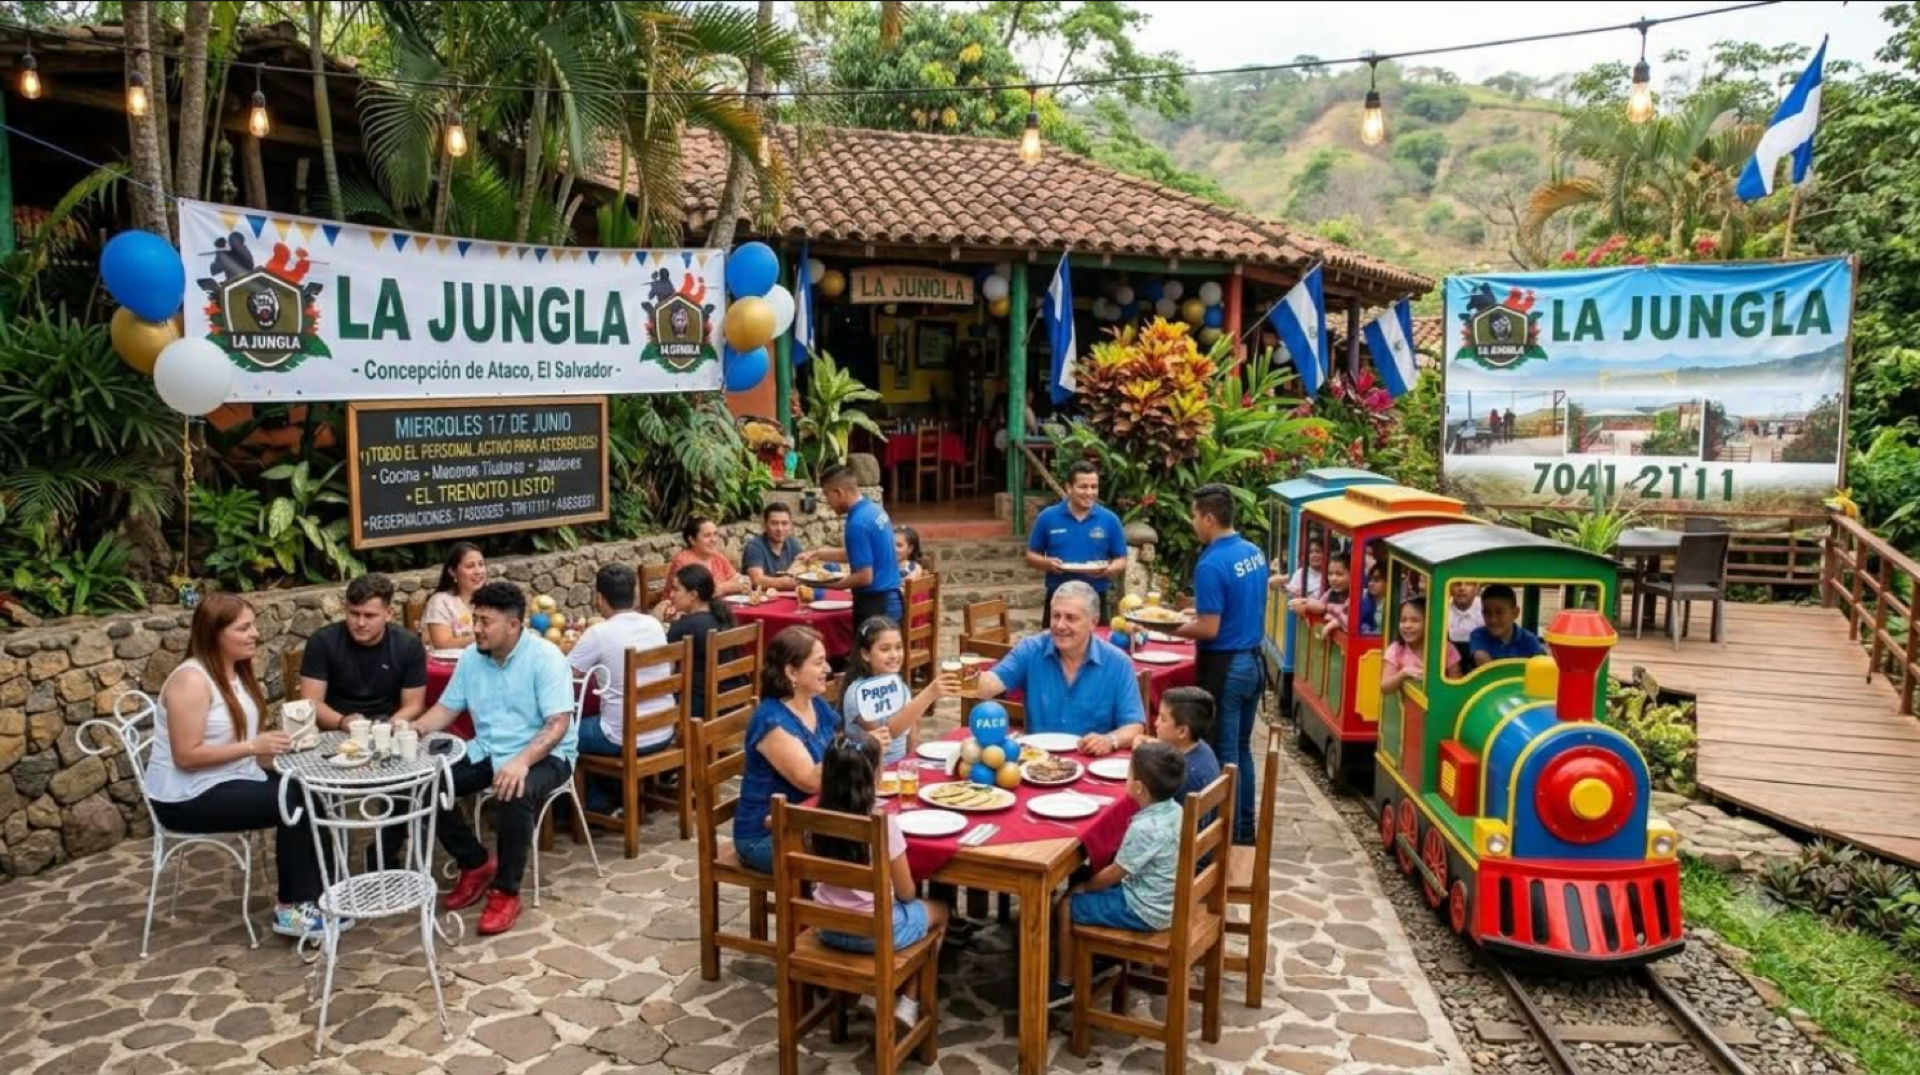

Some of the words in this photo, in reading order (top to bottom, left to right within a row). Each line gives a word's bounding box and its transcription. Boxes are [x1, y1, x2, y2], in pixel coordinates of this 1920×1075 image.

[860, 275, 886, 297] LA
[337, 275, 411, 341] LA
[428, 281, 631, 346] JUNGLA
[1552, 295, 1605, 342] LA
[1623, 288, 1832, 341] JUNGLA
[233, 335, 249, 349] LA
[251, 335, 302, 350] JUNGLA
[363, 359, 461, 386] Concepción
[466, 360, 484, 380] de
[487, 360, 534, 382] Ataco,
[537, 360, 551, 379] El
[554, 360, 613, 379] Salvador
[395, 415, 484, 439] MIERCOLES
[488, 414, 506, 434] 17
[511, 412, 530, 434] DE
[532, 411, 572, 434] JUNIO
[404, 444, 420, 461] EL
[414, 486, 435, 505] EL
[437, 479, 508, 503] TRENCITO
